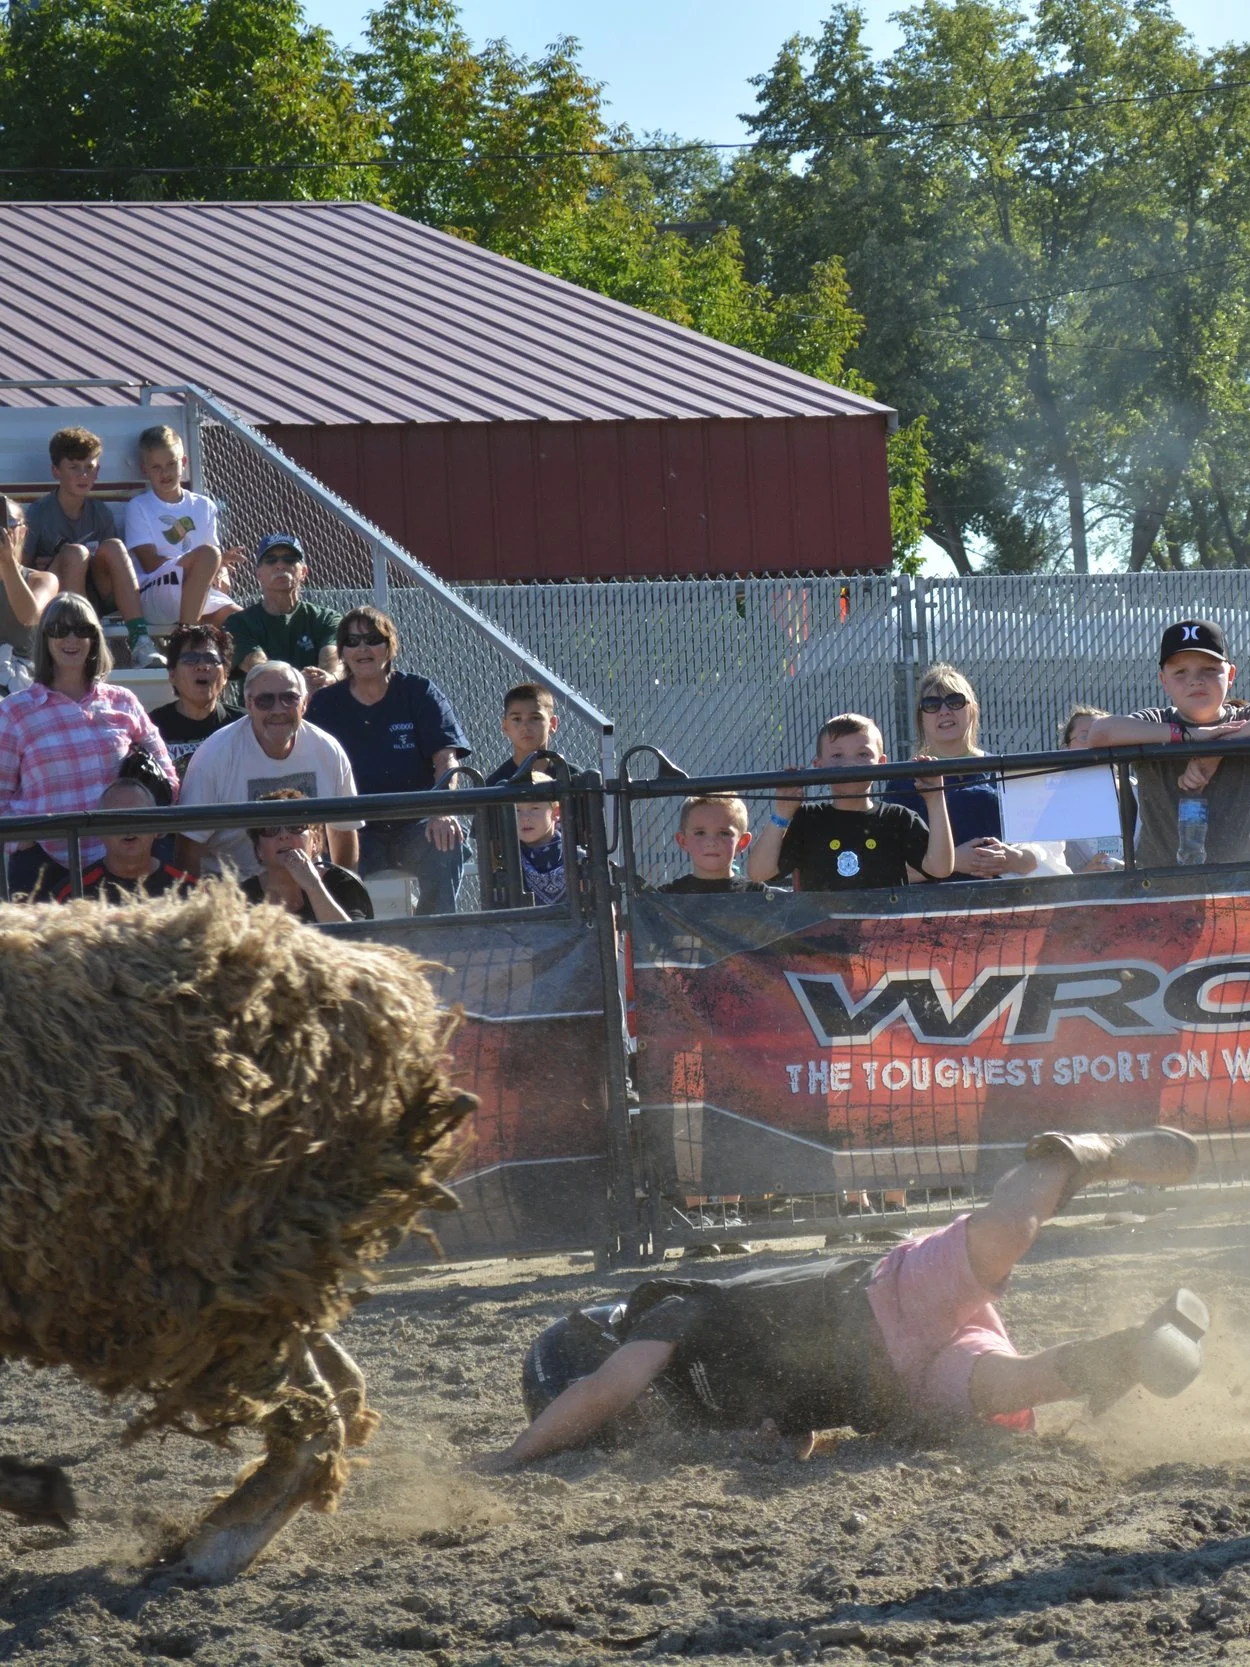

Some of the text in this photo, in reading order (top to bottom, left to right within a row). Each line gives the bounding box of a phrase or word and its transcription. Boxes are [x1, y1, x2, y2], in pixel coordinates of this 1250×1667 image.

[785, 1058, 853, 1095] THE
[862, 1055, 1044, 1091] TOUGHEST
[1053, 1051, 1152, 1085] SPORT
[1161, 1048, 1210, 1080] ON
